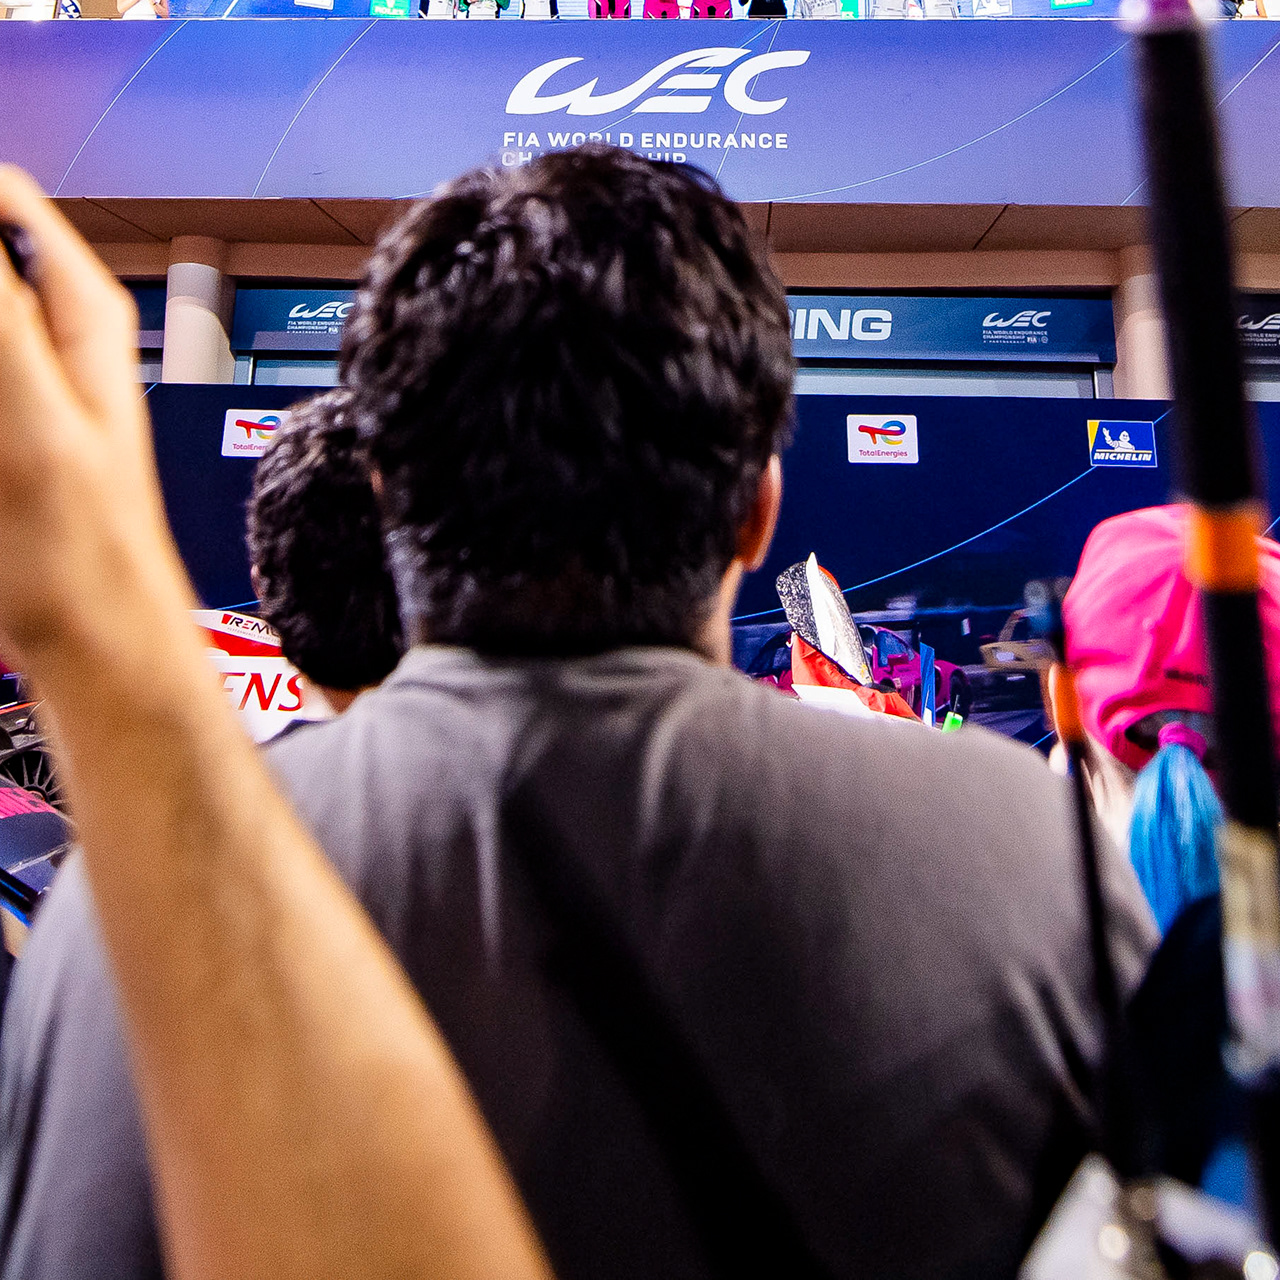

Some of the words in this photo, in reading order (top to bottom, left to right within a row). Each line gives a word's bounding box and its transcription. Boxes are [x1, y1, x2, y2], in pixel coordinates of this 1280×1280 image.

[505, 46, 812, 117] WEC
[503, 131, 541, 148] FIA
[641, 132, 788, 149] ENDURANCE
[288, 301, 356, 318] WEC
[792, 309, 892, 341] ING
[982, 310, 1052, 328] WEC
[858, 449, 908, 459] TotalEnergies
[1093, 452, 1152, 462] MICHELIN
